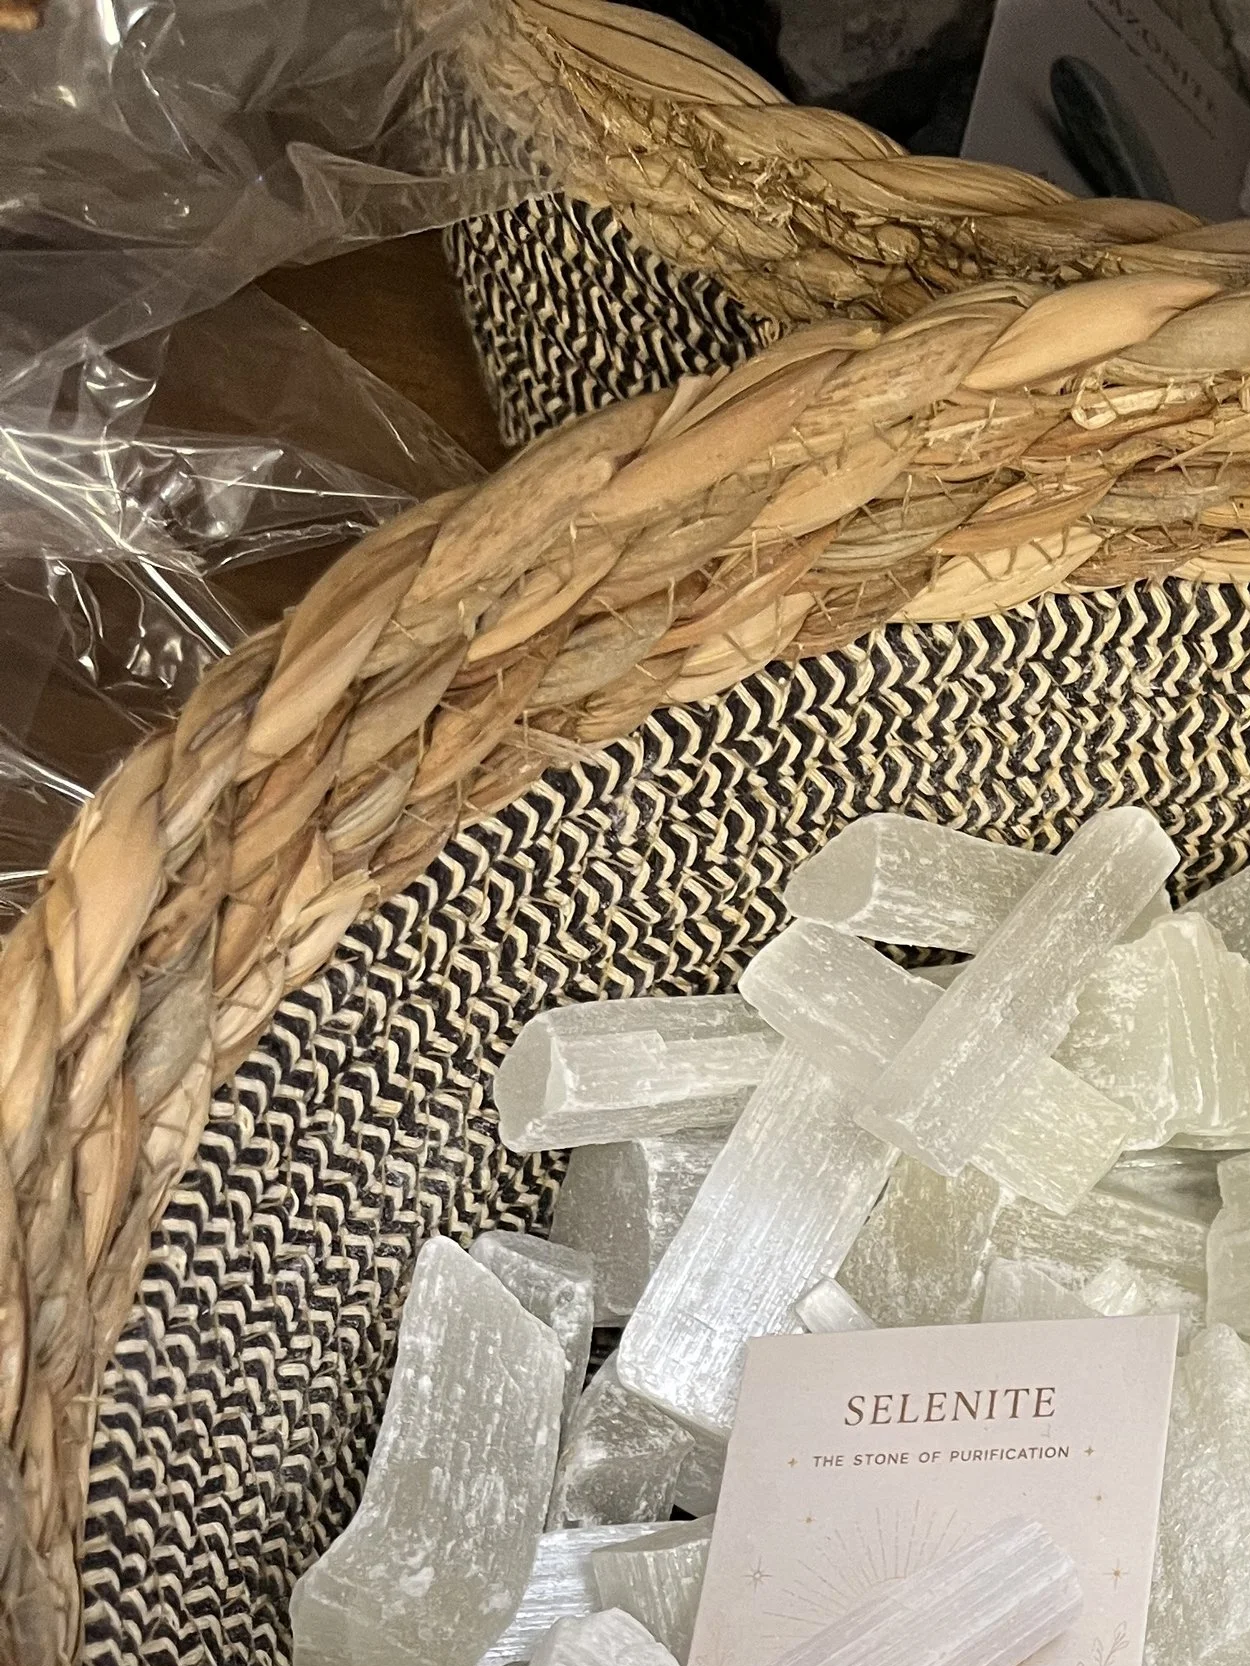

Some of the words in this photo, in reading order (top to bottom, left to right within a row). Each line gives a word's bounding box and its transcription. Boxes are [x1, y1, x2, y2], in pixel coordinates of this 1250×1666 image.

[844, 1387, 1056, 1427] SELENITE
[812, 1455, 845, 1468] THE
[853, 1452, 909, 1466] STONE
[918, 1450, 942, 1464] OF
[950, 1446, 1070, 1463] PURIFICATION
